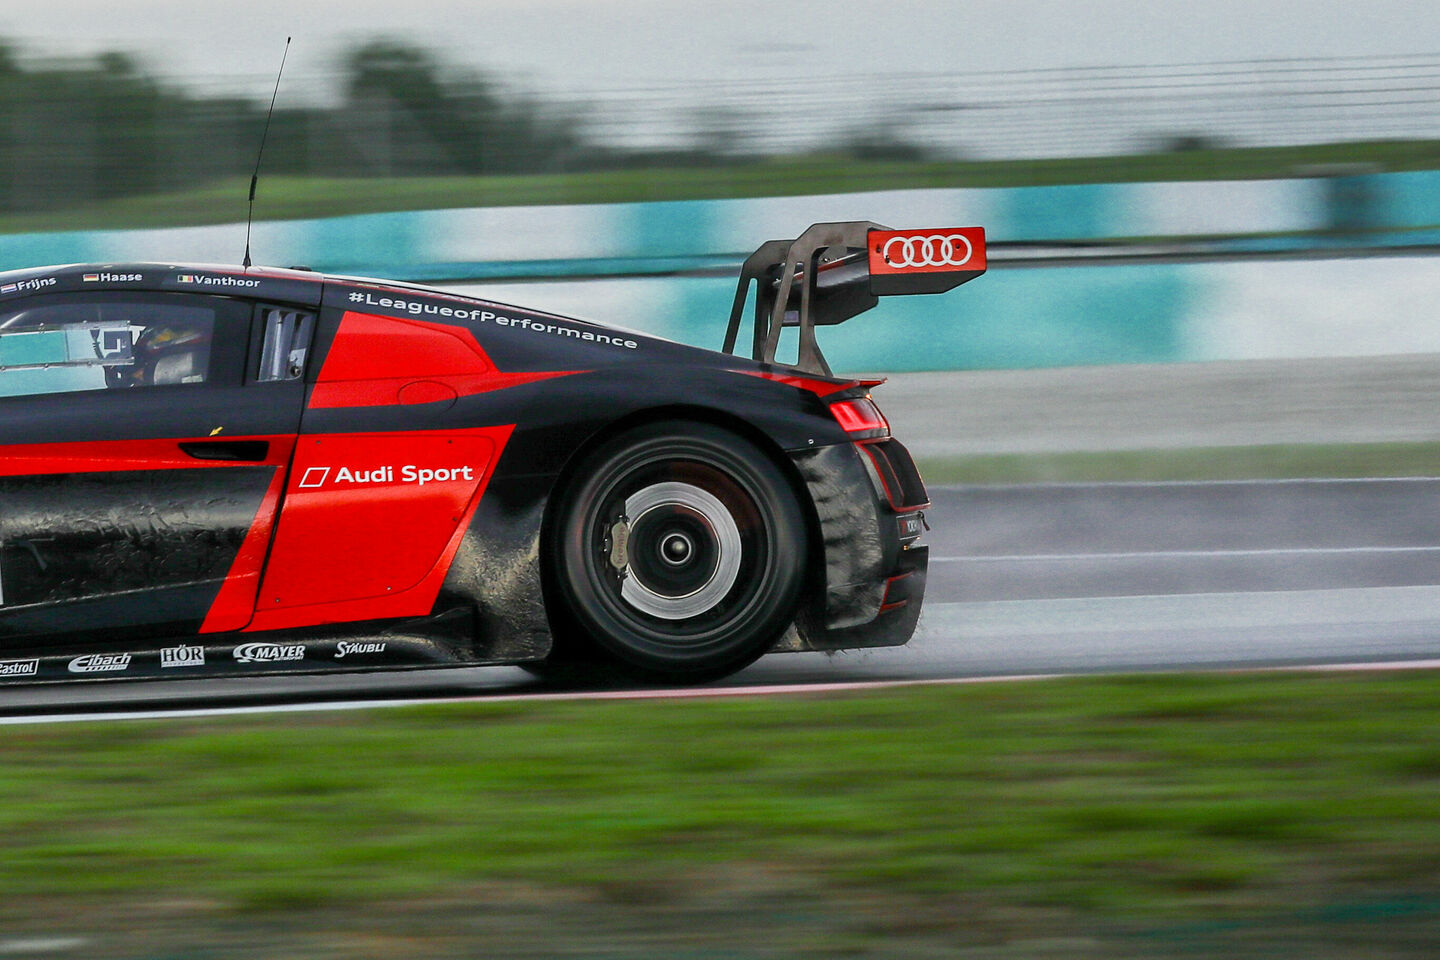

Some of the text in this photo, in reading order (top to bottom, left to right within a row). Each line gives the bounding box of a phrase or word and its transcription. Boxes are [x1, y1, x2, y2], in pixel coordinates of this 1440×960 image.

[17, 276, 57, 291] Frijns
[101, 272, 143, 282] Haase
[194, 275, 260, 288] Vanthoor
[349, 291, 638, 349] #LeagueofPerformance
[335, 465, 474, 486] Audi Sport
[162, 644, 205, 662] HÖR
[255, 645, 306, 659] MAYER
[68, 652, 132, 673] Eibach
